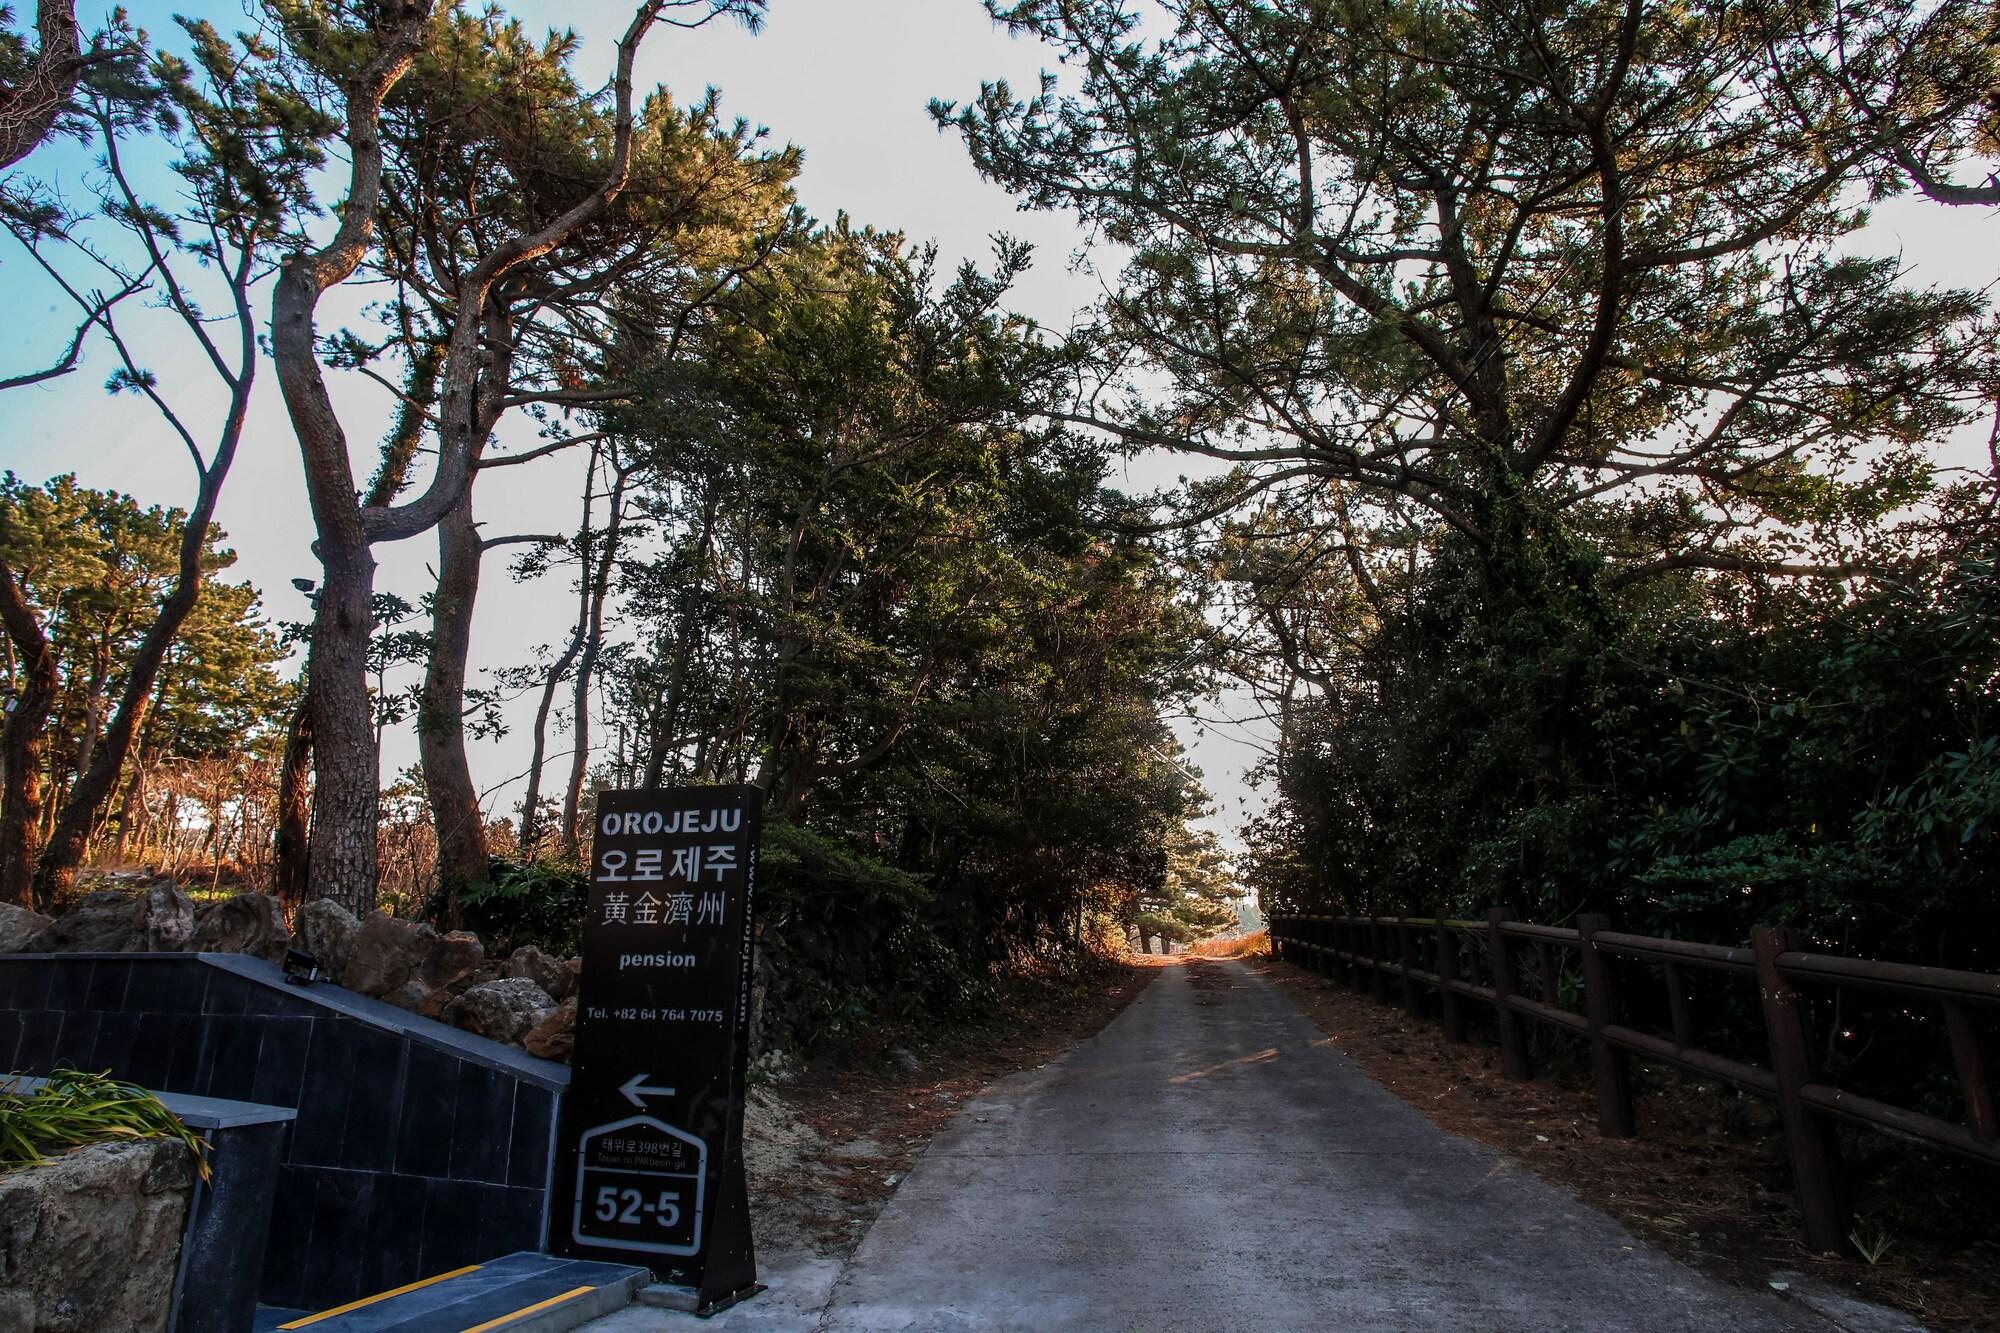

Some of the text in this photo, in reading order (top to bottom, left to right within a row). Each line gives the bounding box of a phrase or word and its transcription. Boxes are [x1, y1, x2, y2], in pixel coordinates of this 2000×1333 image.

[602, 808, 741, 836] OROJEJU
[596, 845, 738, 883] 오로제주
[739, 849, 756, 1023] www.orojeju.com
[619, 951, 696, 971] pension
[587, 1007, 723, 1022] Tel. +82 64 764 7075
[602, 1137, 682, 1158] 태위로398번길
[596, 1186, 680, 1227] 52-5
